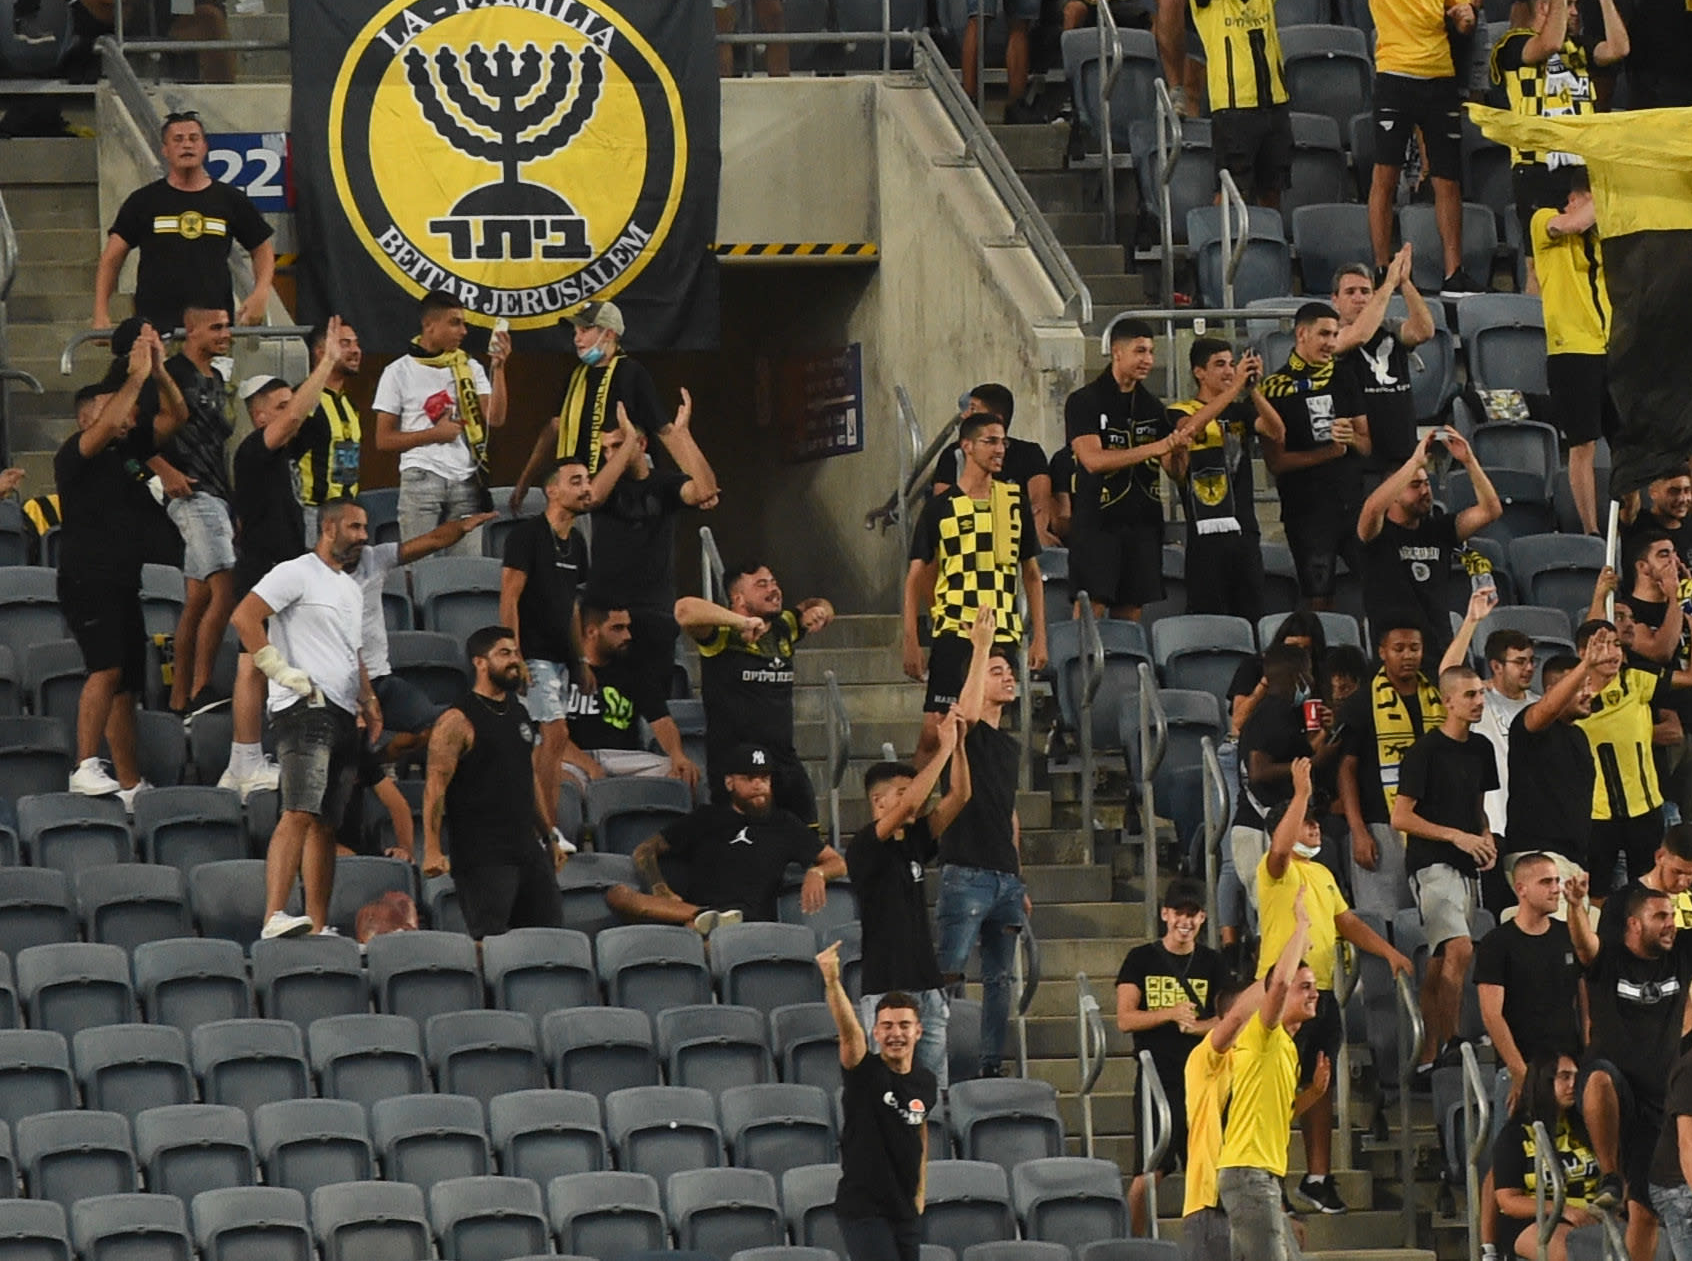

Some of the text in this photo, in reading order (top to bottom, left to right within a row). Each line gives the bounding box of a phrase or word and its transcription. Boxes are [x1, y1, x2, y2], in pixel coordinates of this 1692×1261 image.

[376, 8, 433, 55] LA
[208, 148, 285, 197] 22
[428, 216, 592, 261] ביתר
[373, 218, 653, 316] BEITAR JERUSALEM
